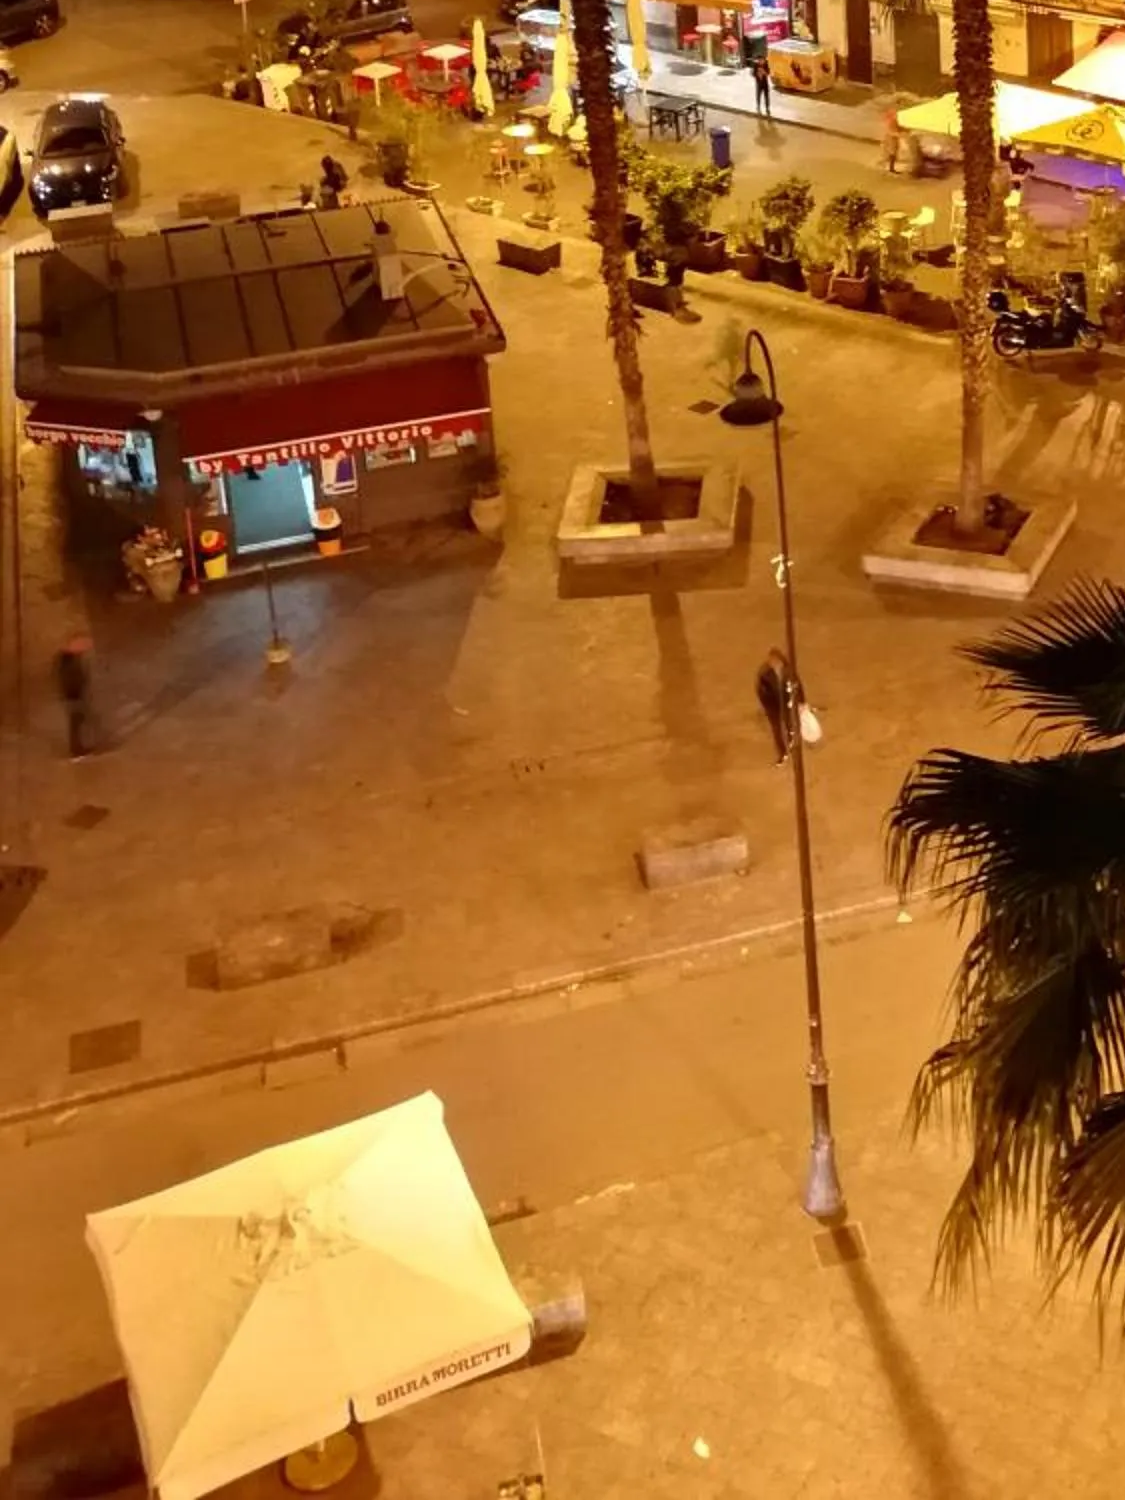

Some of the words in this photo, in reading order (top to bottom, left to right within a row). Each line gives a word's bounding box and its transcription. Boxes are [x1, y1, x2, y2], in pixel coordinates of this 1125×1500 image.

[199, 457, 223, 474] by
[340, 424, 433, 450] Vittorio
[375, 1374, 430, 1407] BIRRA
[431, 1341, 511, 1382] MORETTI
